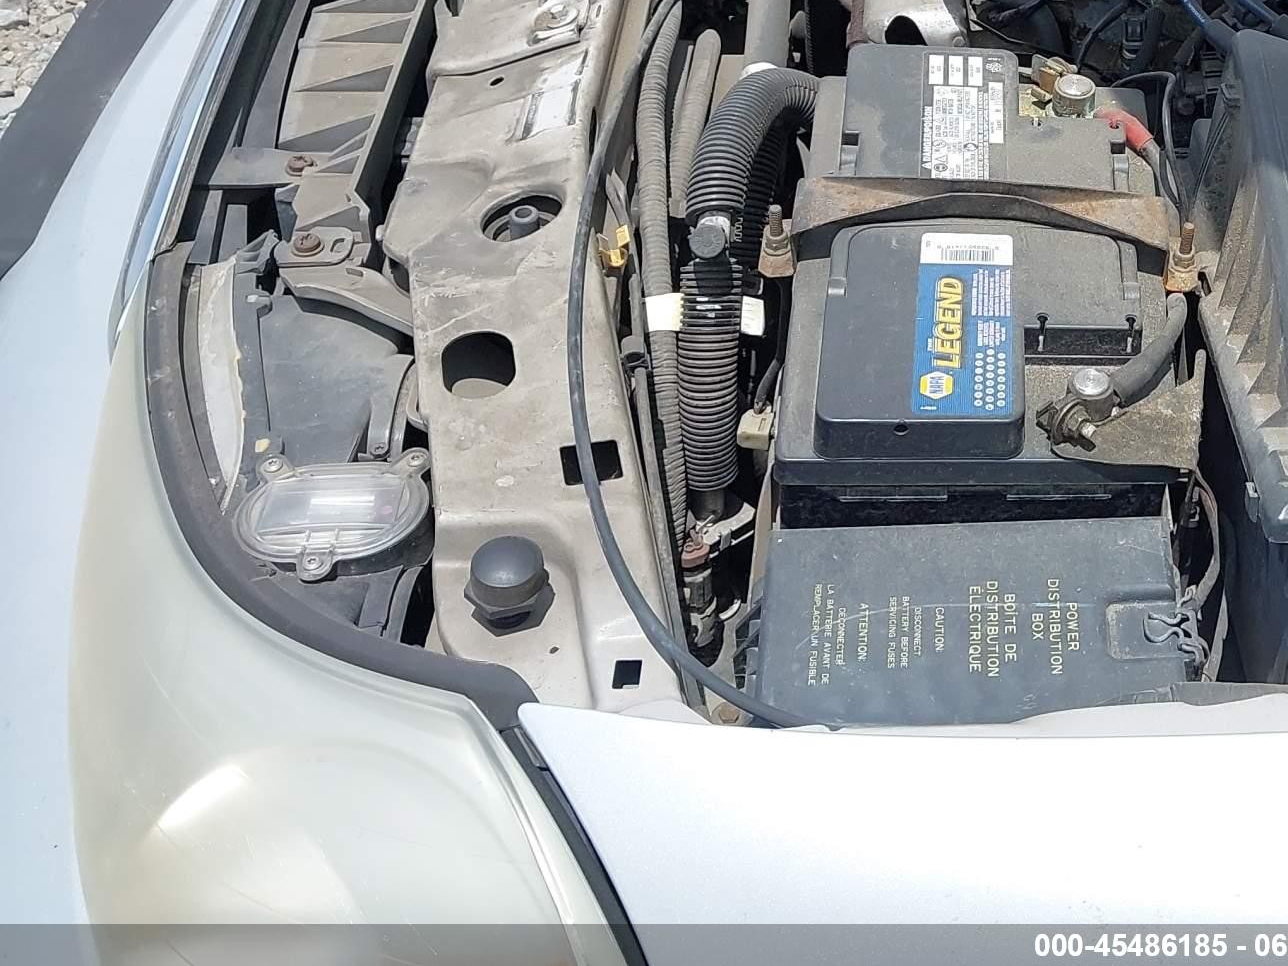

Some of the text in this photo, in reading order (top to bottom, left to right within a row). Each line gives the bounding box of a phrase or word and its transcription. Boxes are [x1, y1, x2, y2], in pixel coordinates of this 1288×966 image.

[932, 276, 963, 369] LEGEND
[929, 375, 945, 395] NAPA
[807, 583, 823, 687] REMPLACER UN FUSIBLE
[821, 584, 835, 686] LA BATTERIE AVANT DE
[857, 603, 869, 663] ATTENTION:
[887, 596, 898, 669] SERVICING FUSES
[899, 596, 910, 669] BATTERY BEFORE
[913, 607, 922, 657] DISCONNECT
[969, 585, 985, 673] ÉLECTRIQUE
[986, 580, 1000, 678] DISTRIBUTION
[1004, 644, 1018, 663] DE
[1032, 613, 1044, 641] BOX
[1047, 579, 1063, 676] DISTRIBUTION
[1066, 602, 1080, 652] POWER
